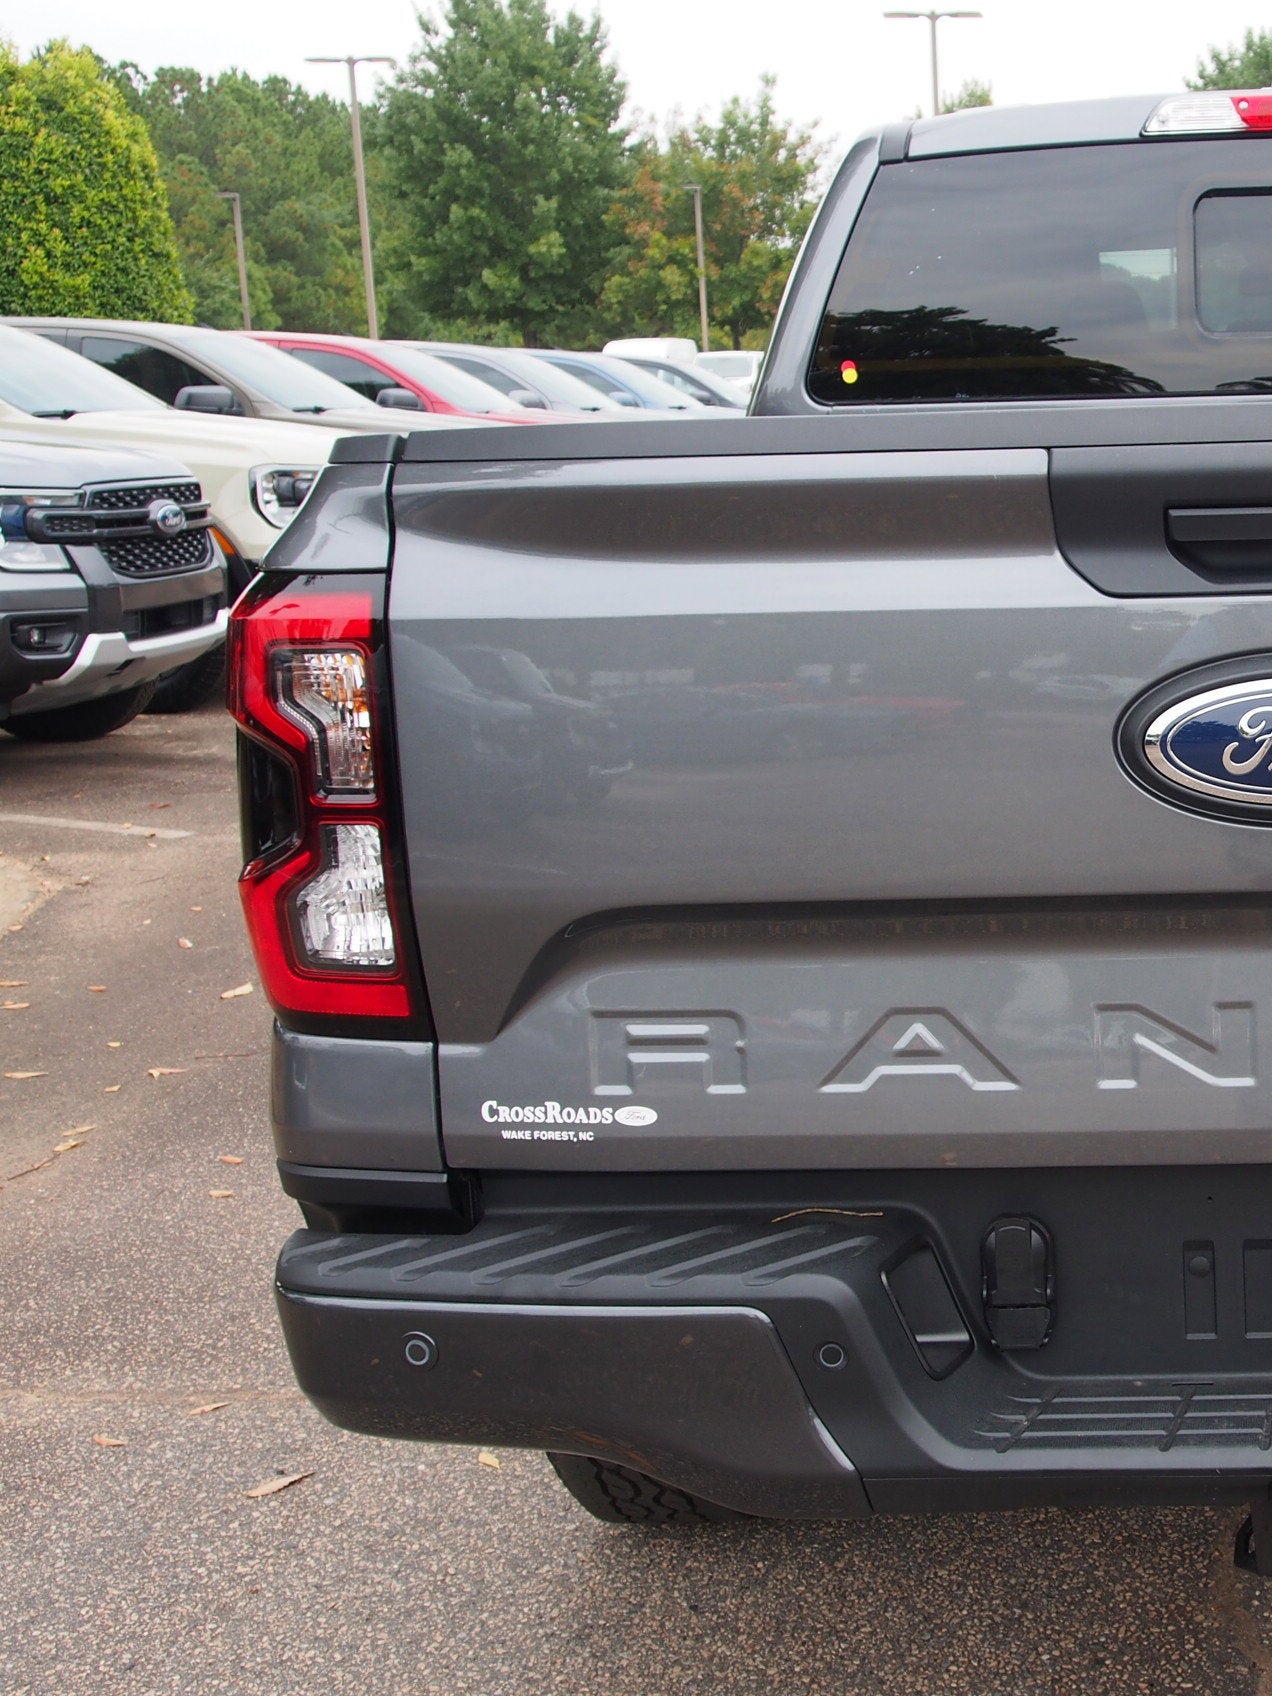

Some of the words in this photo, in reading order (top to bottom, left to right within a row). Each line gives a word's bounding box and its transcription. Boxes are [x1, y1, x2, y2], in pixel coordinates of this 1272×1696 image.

[501, 1129, 532, 1140] WAKE
[533, 1130, 577, 1142] FOREST,
[578, 1131, 594, 1141] NC
